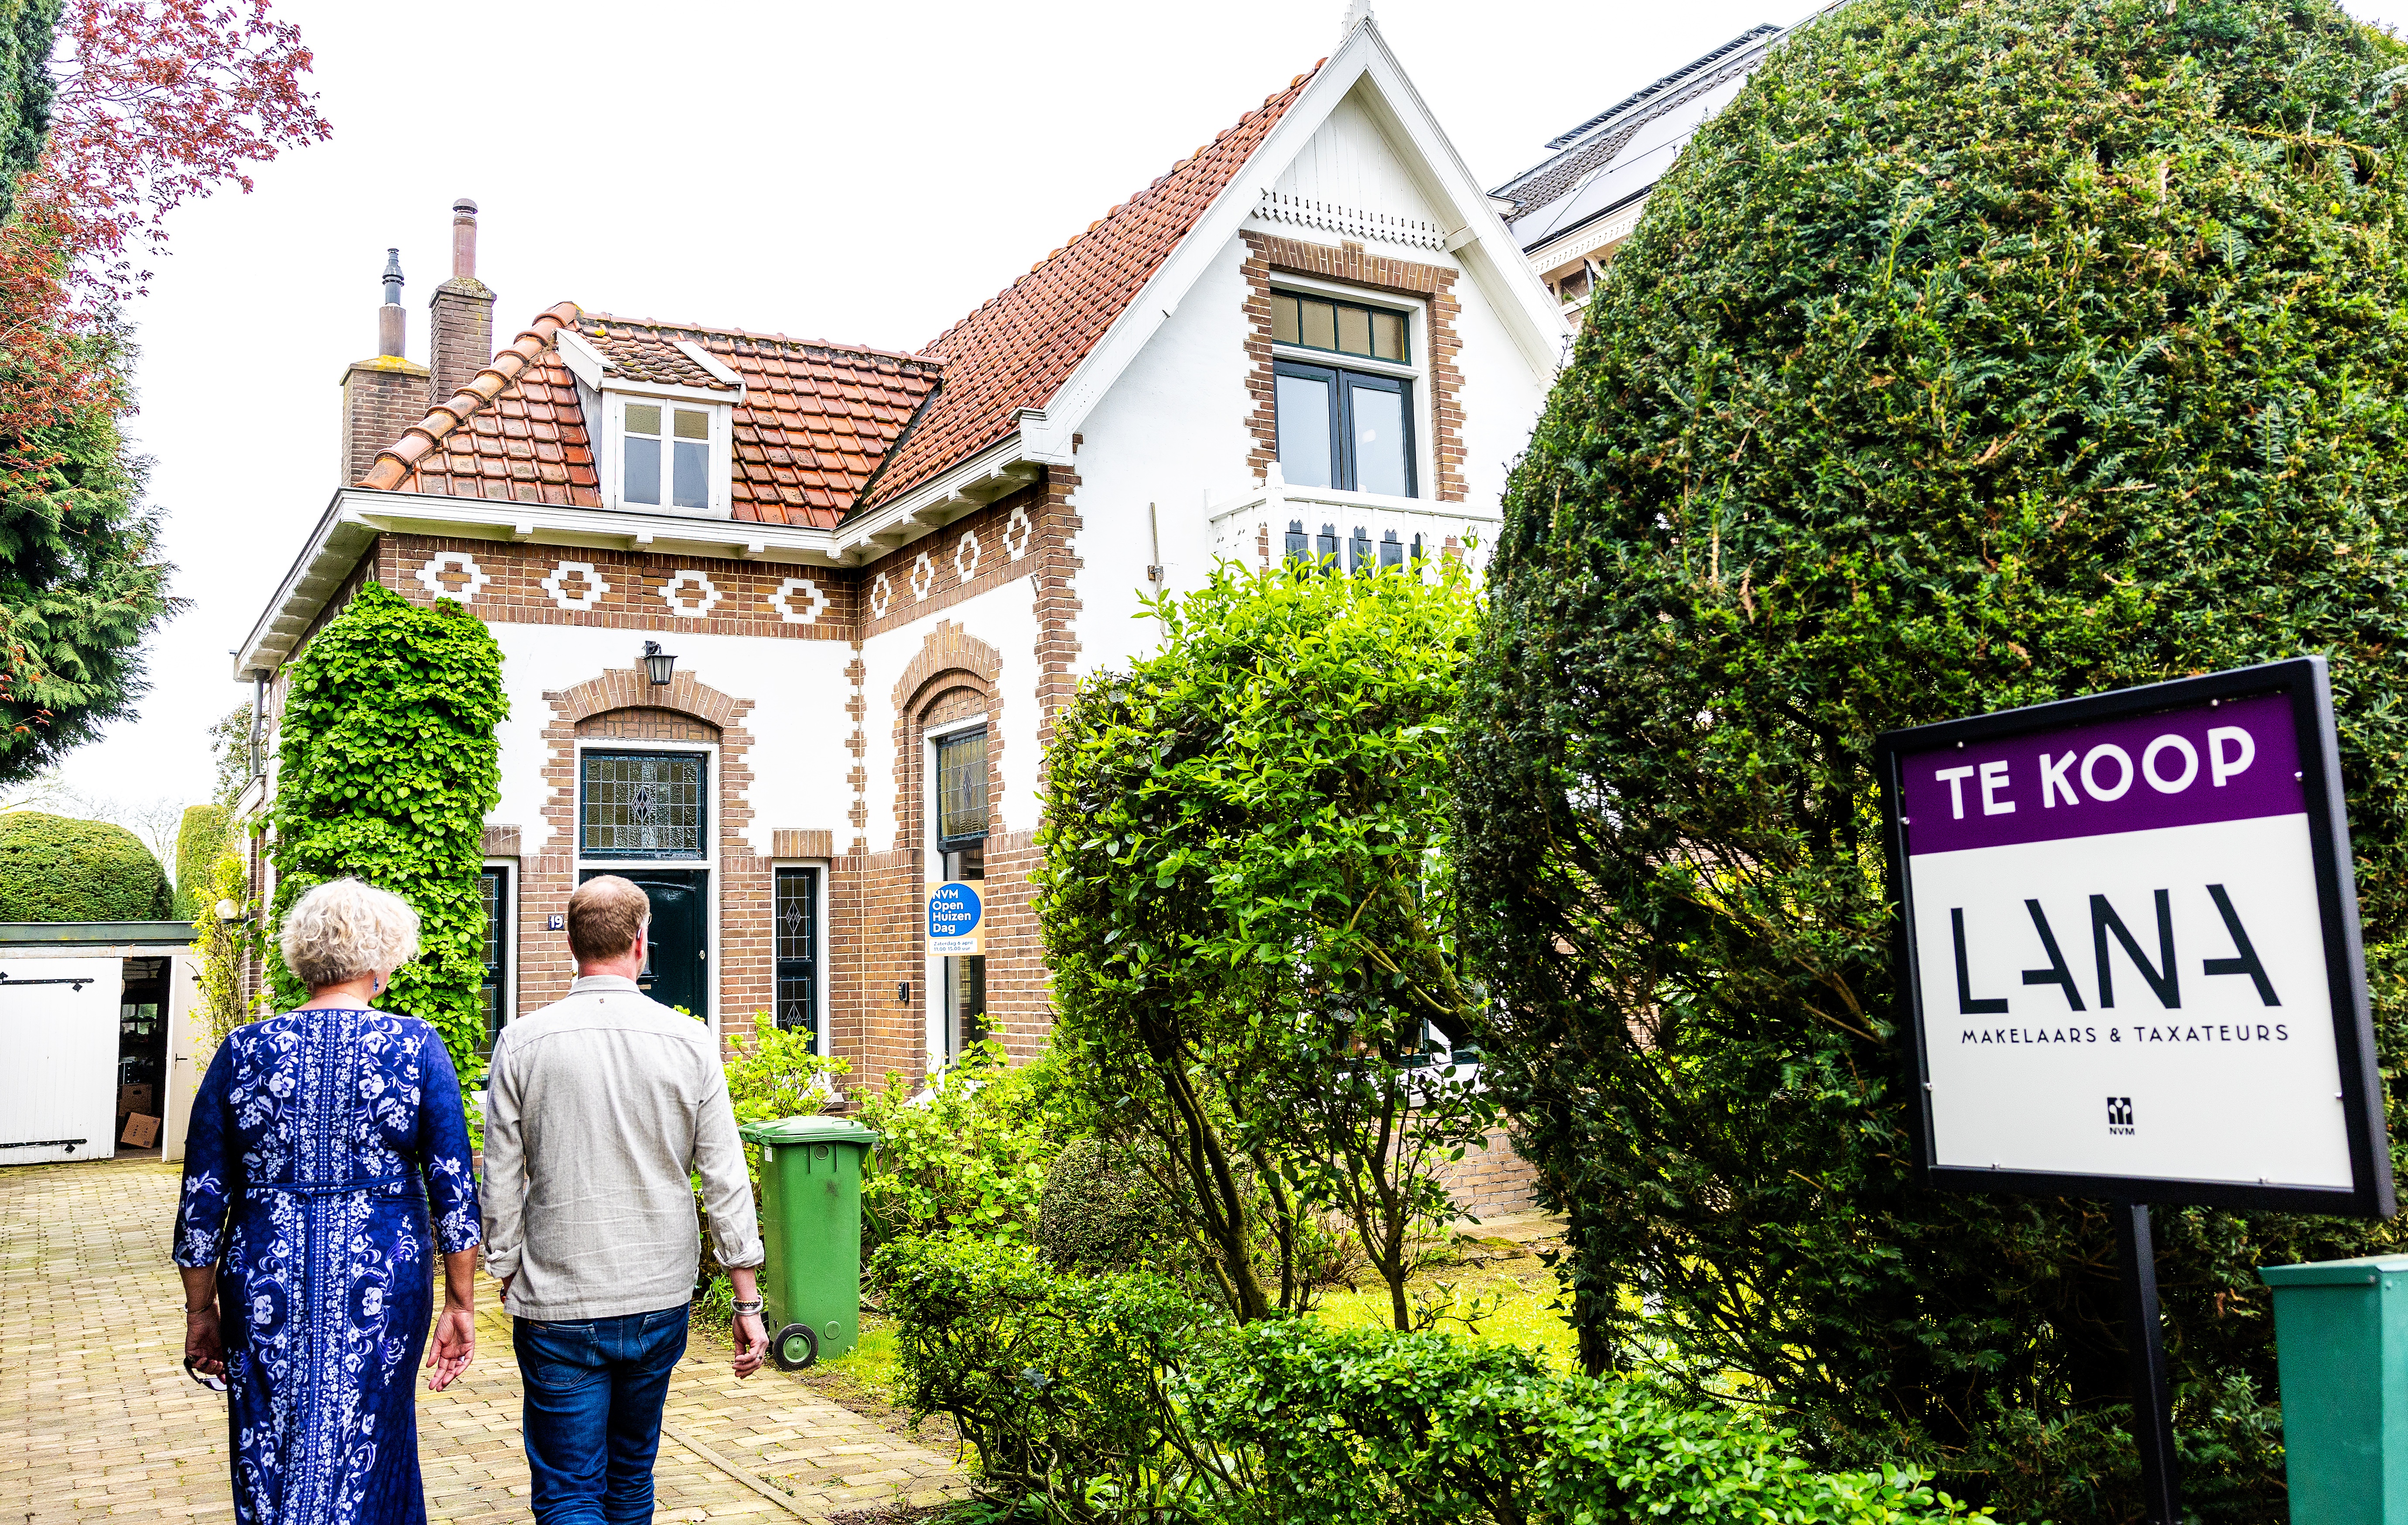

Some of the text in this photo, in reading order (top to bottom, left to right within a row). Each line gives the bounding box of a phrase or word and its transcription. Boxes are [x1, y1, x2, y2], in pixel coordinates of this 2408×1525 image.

[1935, 726, 2255, 820] TE KOOP
[932, 889, 958, 899] NVM
[932, 901, 963, 912] Open
[550, 915, 563, 928] 19
[933, 910, 971, 922] Huizen
[933, 923, 955, 934] Dag
[1950, 884, 2282, 1014] LANA
[1962, 1024, 2288, 1044] MAKELAARS & TAXATEURS
